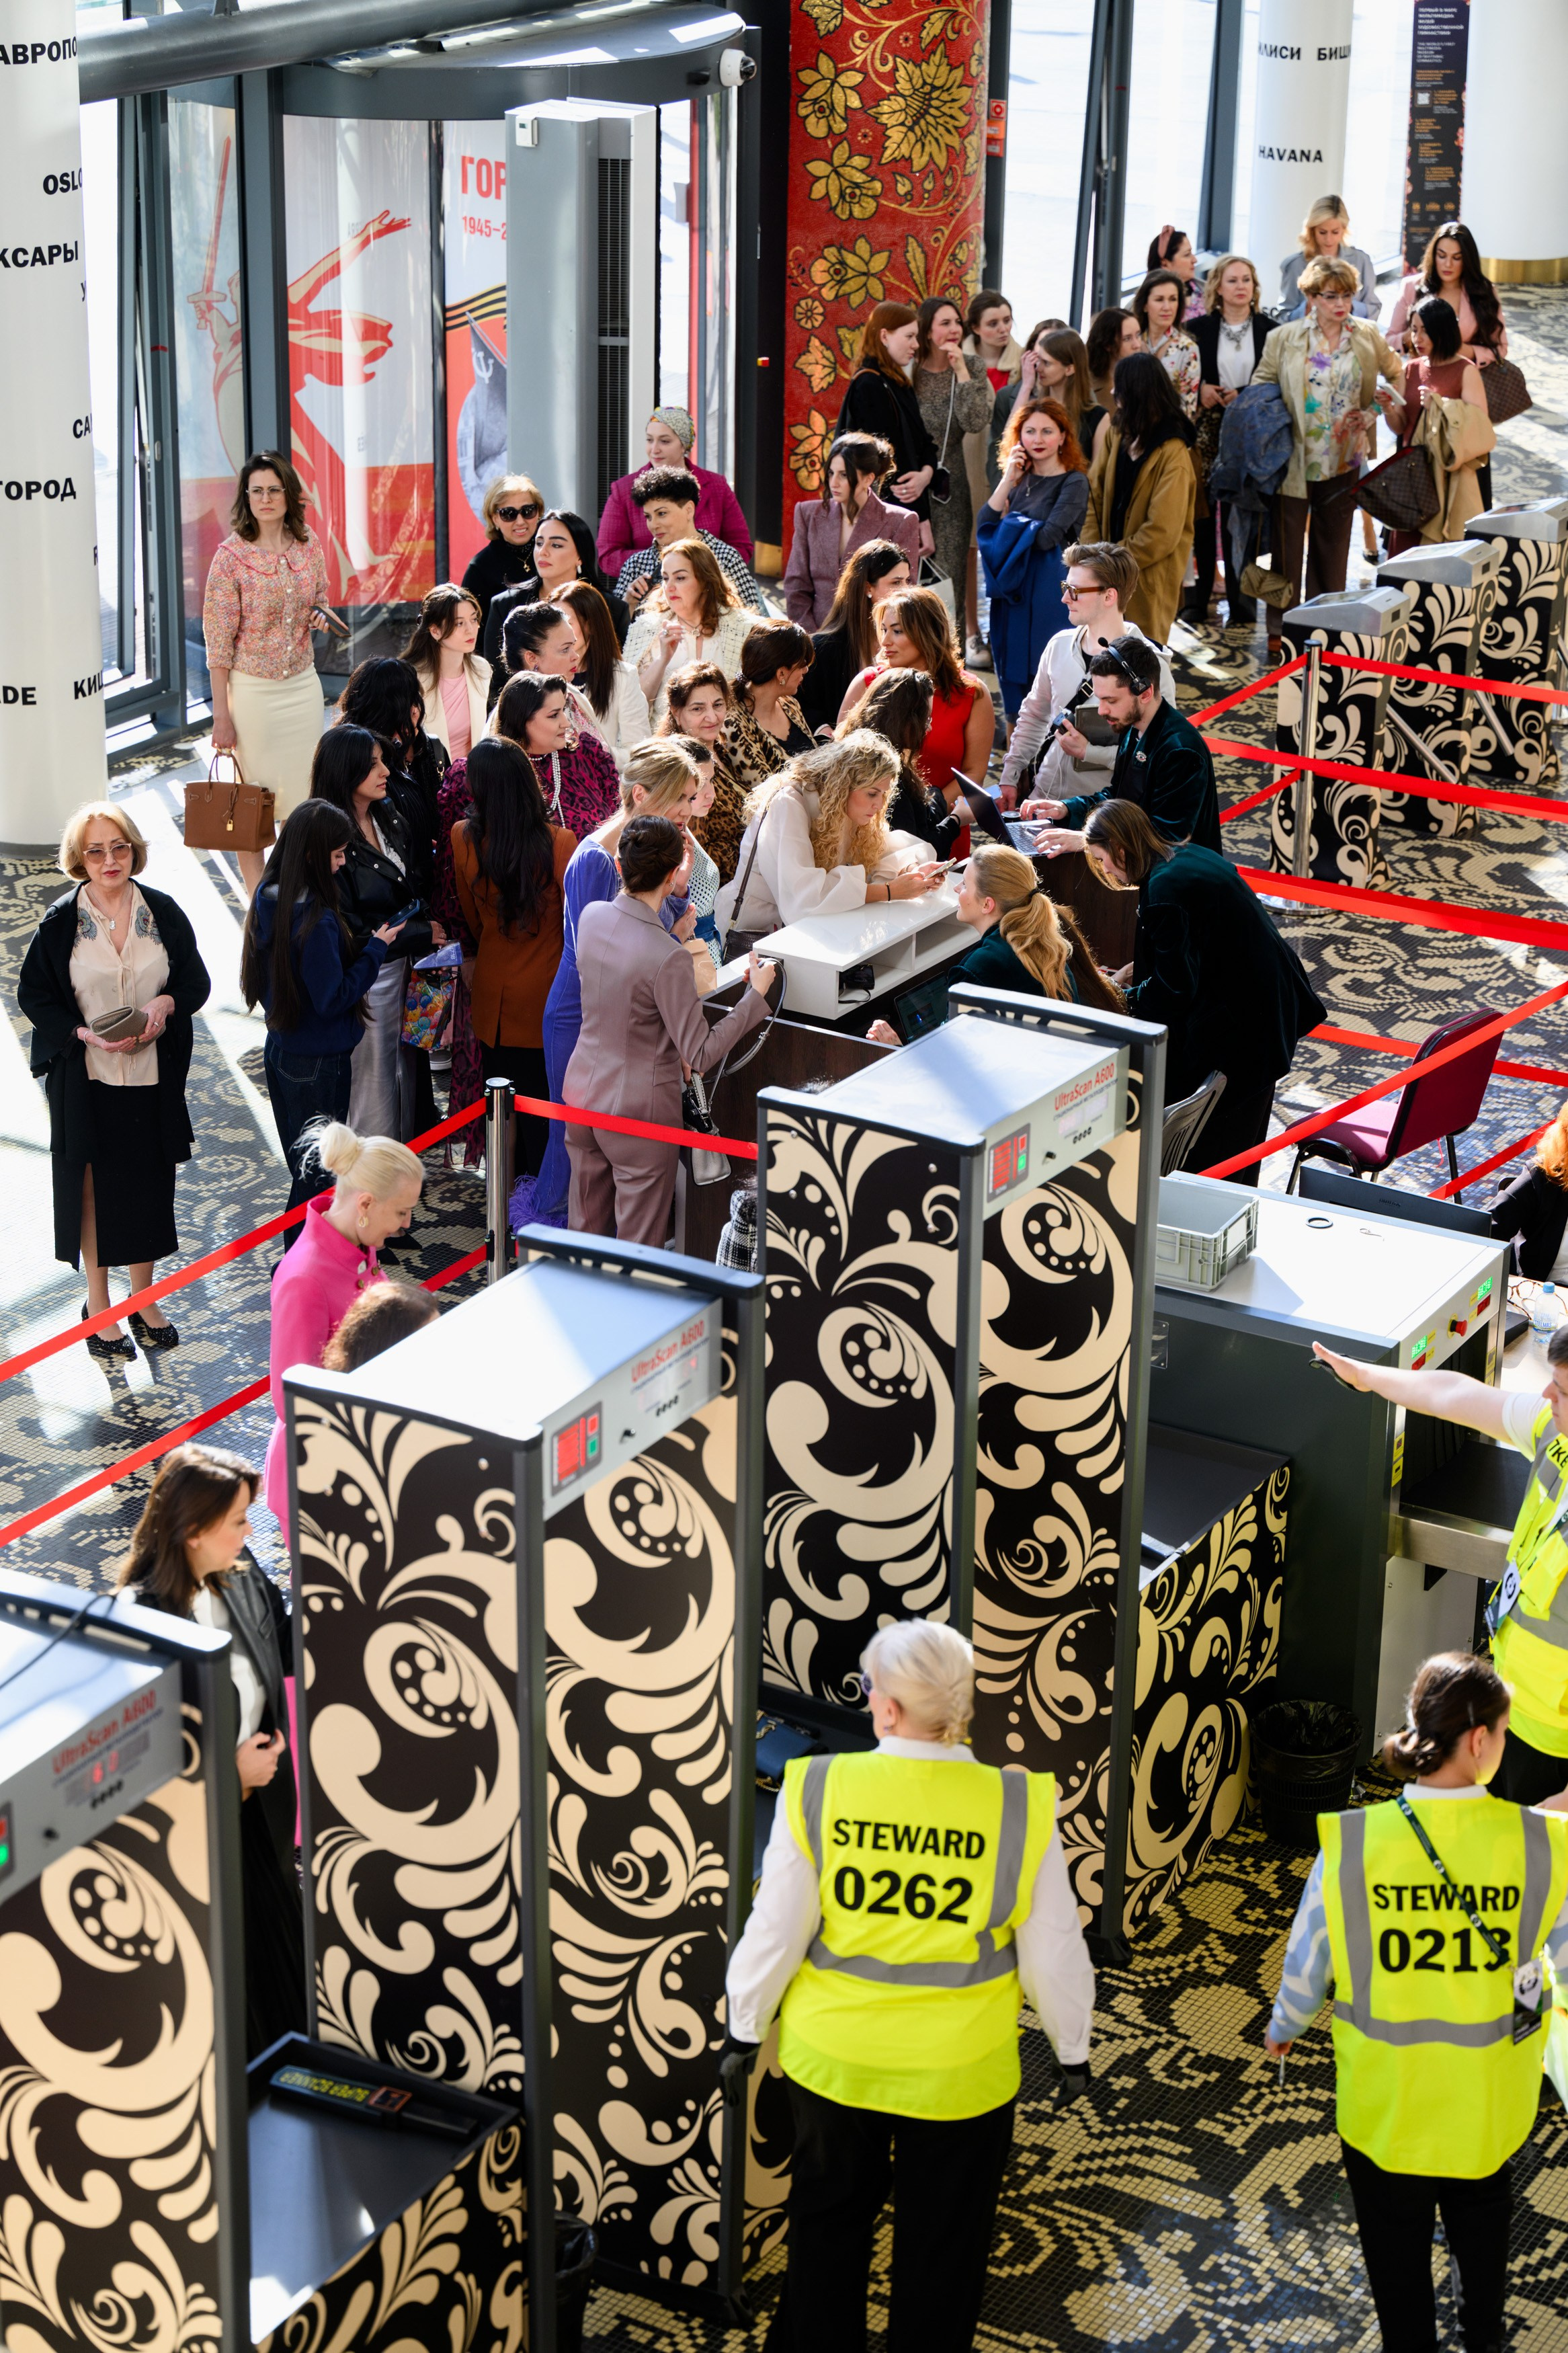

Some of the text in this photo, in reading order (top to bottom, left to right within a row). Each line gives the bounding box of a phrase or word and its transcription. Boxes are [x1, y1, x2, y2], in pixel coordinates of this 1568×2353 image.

[1259, 145, 1323, 163] HAVANA
[461, 155, 506, 200] ГОР
[73, 413, 92, 439] СА
[0, 477, 77, 502] ОРОД
[0, 685, 37, 706] DE
[1055, 1062, 1114, 1111] UltraScan A600
[832, 1819, 985, 1860] STEWARD
[834, 1866, 973, 1925] 0262
[1373, 1884, 1520, 1912] STEWARD
